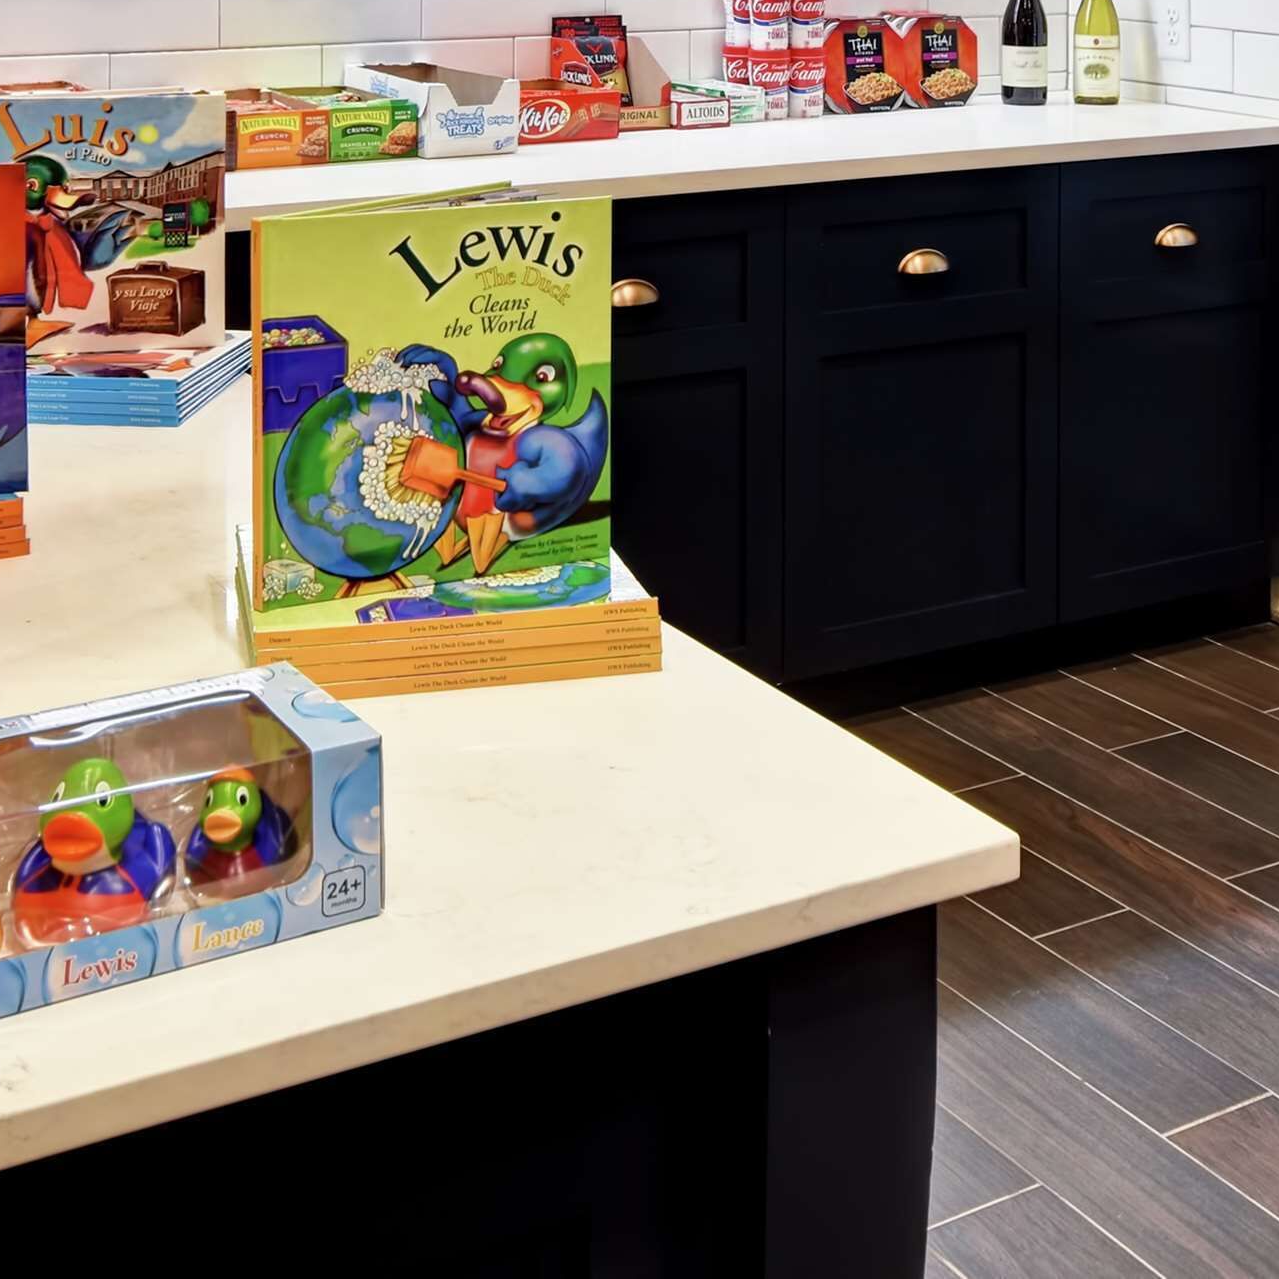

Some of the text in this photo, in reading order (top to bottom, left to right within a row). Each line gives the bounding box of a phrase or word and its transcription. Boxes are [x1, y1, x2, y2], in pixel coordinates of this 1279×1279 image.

[848, 37, 877, 53] THAI
[925, 33, 952, 47] THAI
[364, 110, 389, 123] VALLEY
[620, 110, 659, 120] RIGINAL
[687, 107, 725, 119] ALTOIDS
[255, 133, 289, 141] CRUNCHY
[346, 126, 379, 134] CRUNCHY
[448, 125, 483, 136] TREATS
[64, 146, 112, 166] el Pato
[389, 211, 583, 302] Lewis
[113, 285, 173, 301] y su Largo
[475, 265, 571, 306] The Duck
[129, 299, 159, 313] Viaje
[469, 294, 531, 315] Cleans
[443, 310, 537, 339] the World
[326, 878, 362, 900] 24+
[330, 895, 358, 909] months
[191, 919, 265, 953] Lance
[62, 949, 137, 987] Lewis
